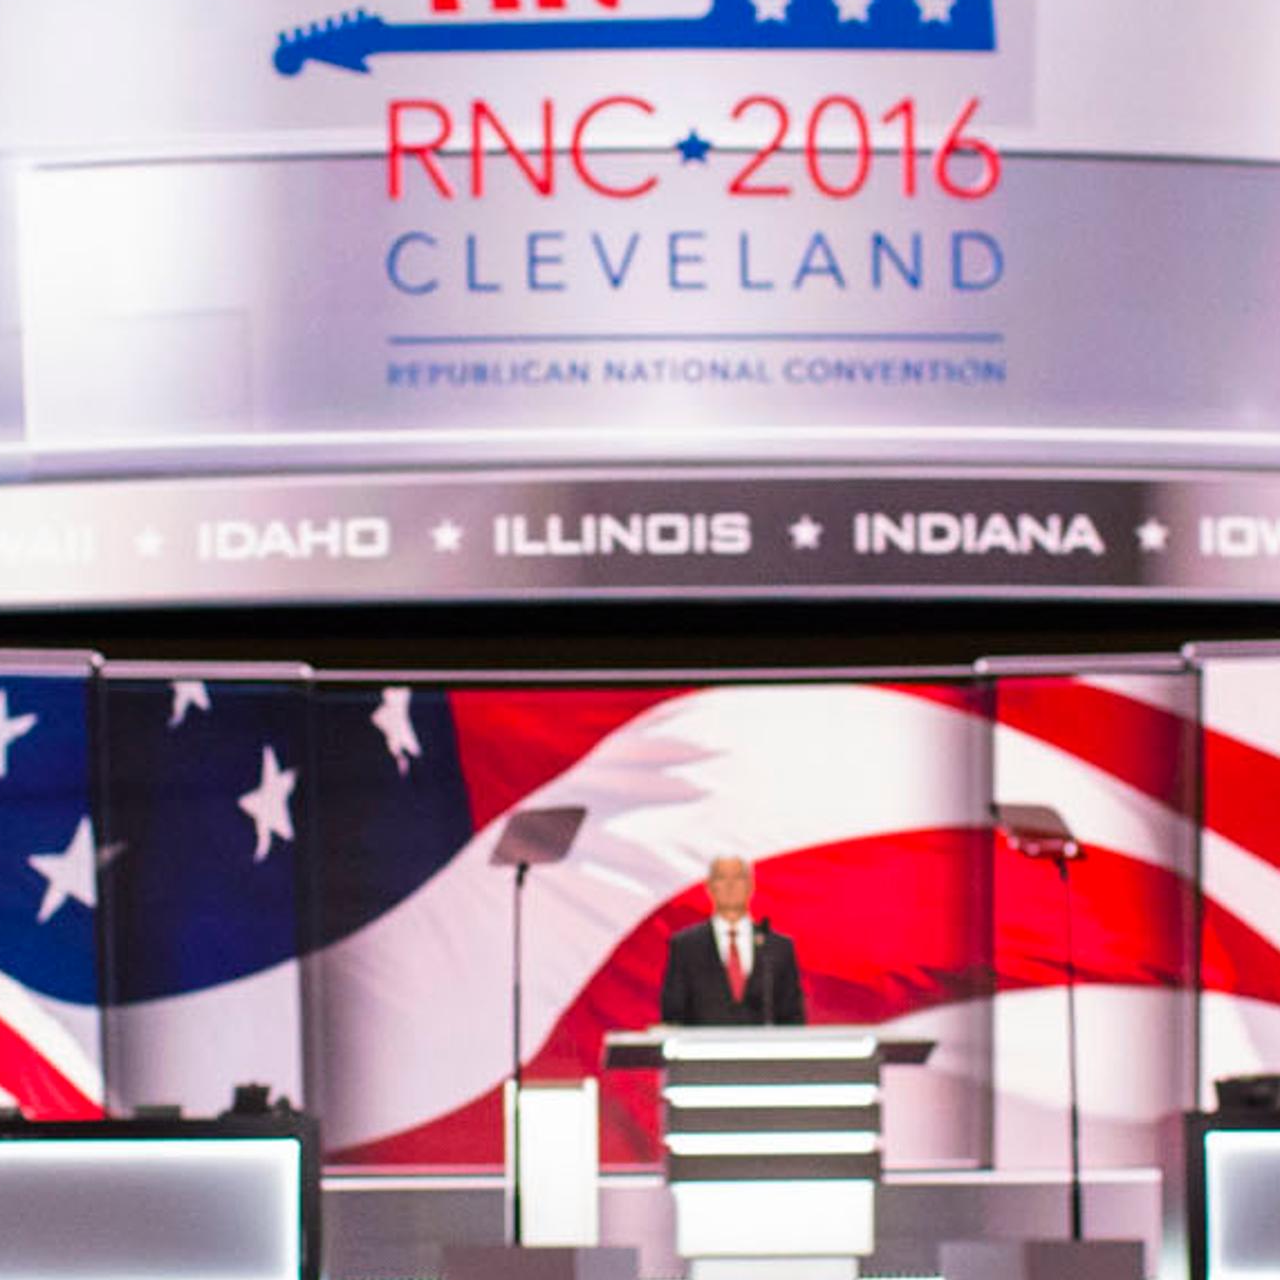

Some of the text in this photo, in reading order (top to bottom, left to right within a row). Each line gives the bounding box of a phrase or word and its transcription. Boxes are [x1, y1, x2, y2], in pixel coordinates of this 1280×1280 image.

[387, 94, 1003, 200] RNC 2016
[385, 230, 1006, 295] CLEVELAND
[386, 359, 1006, 388] REPUBLICAN NATIONAL CONVENTION
[197, 518, 390, 559] IDAHO
[493, 513, 752, 555] ILLINOIS
[853, 513, 1106, 555] INDIANA
